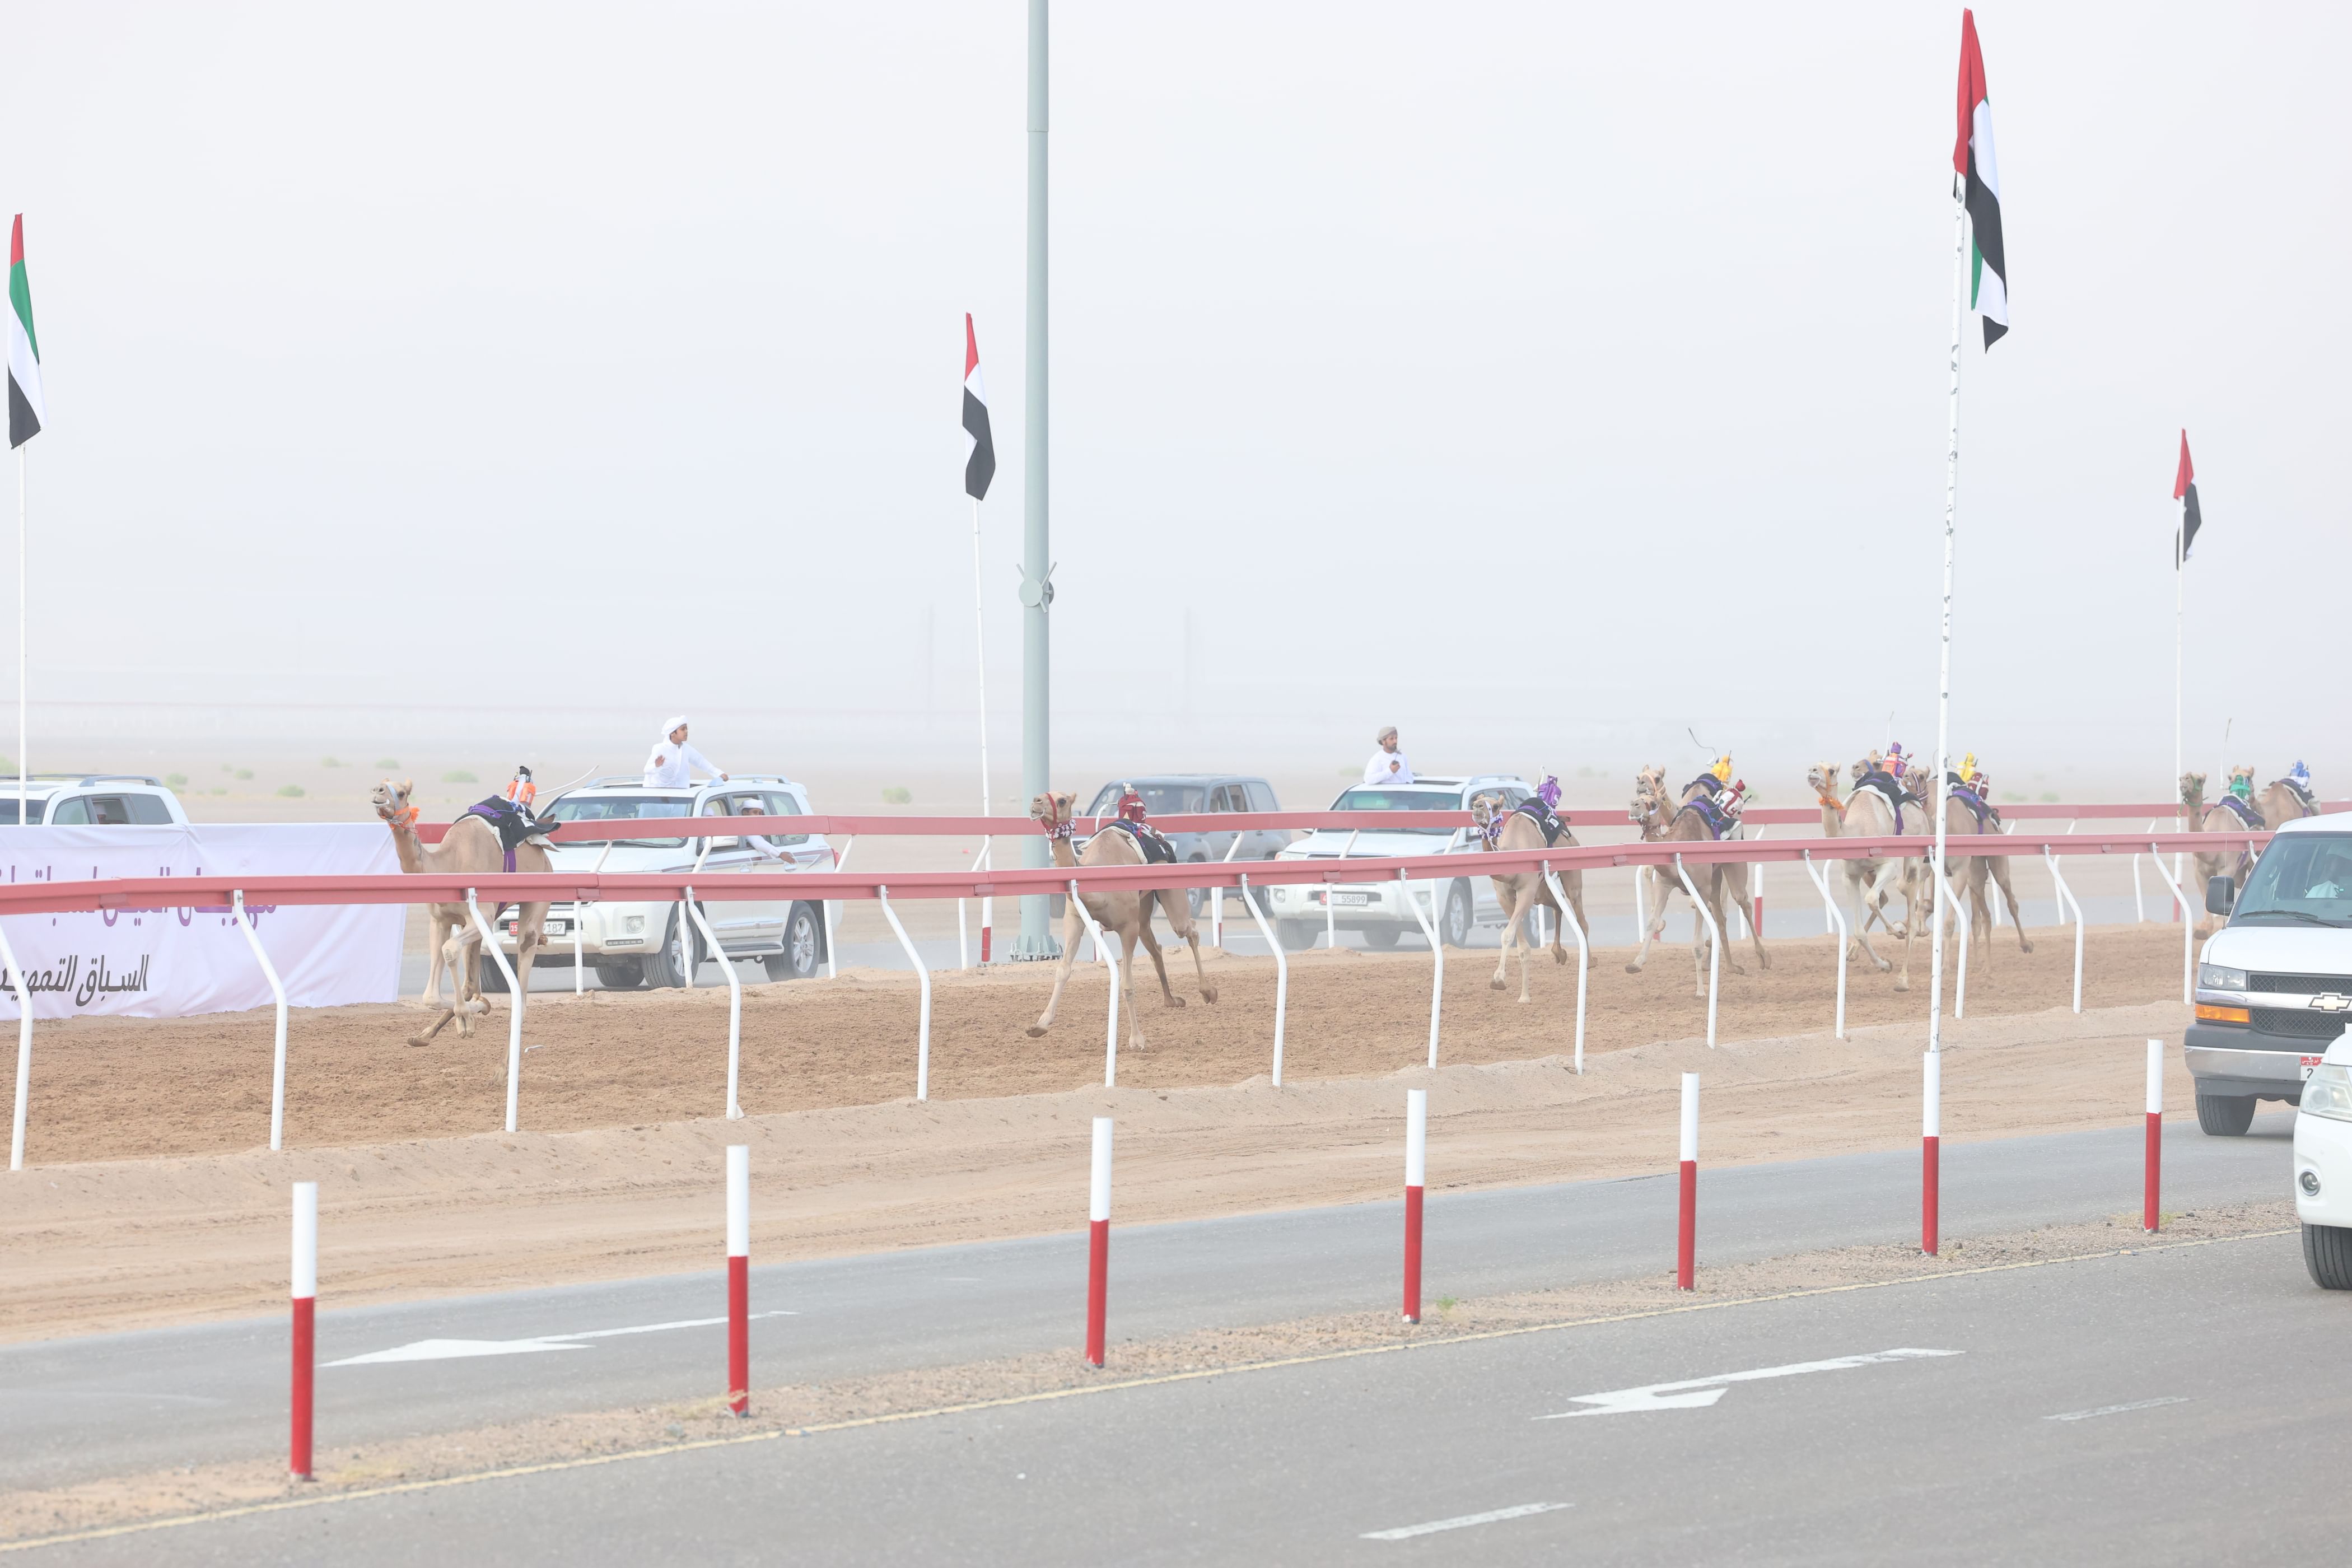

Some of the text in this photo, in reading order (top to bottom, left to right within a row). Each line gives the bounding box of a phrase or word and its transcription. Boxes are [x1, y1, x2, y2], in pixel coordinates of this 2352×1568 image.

[543, 923, 563, 932] 187
[0, 954, 149, 1006] السباق التمهيد
